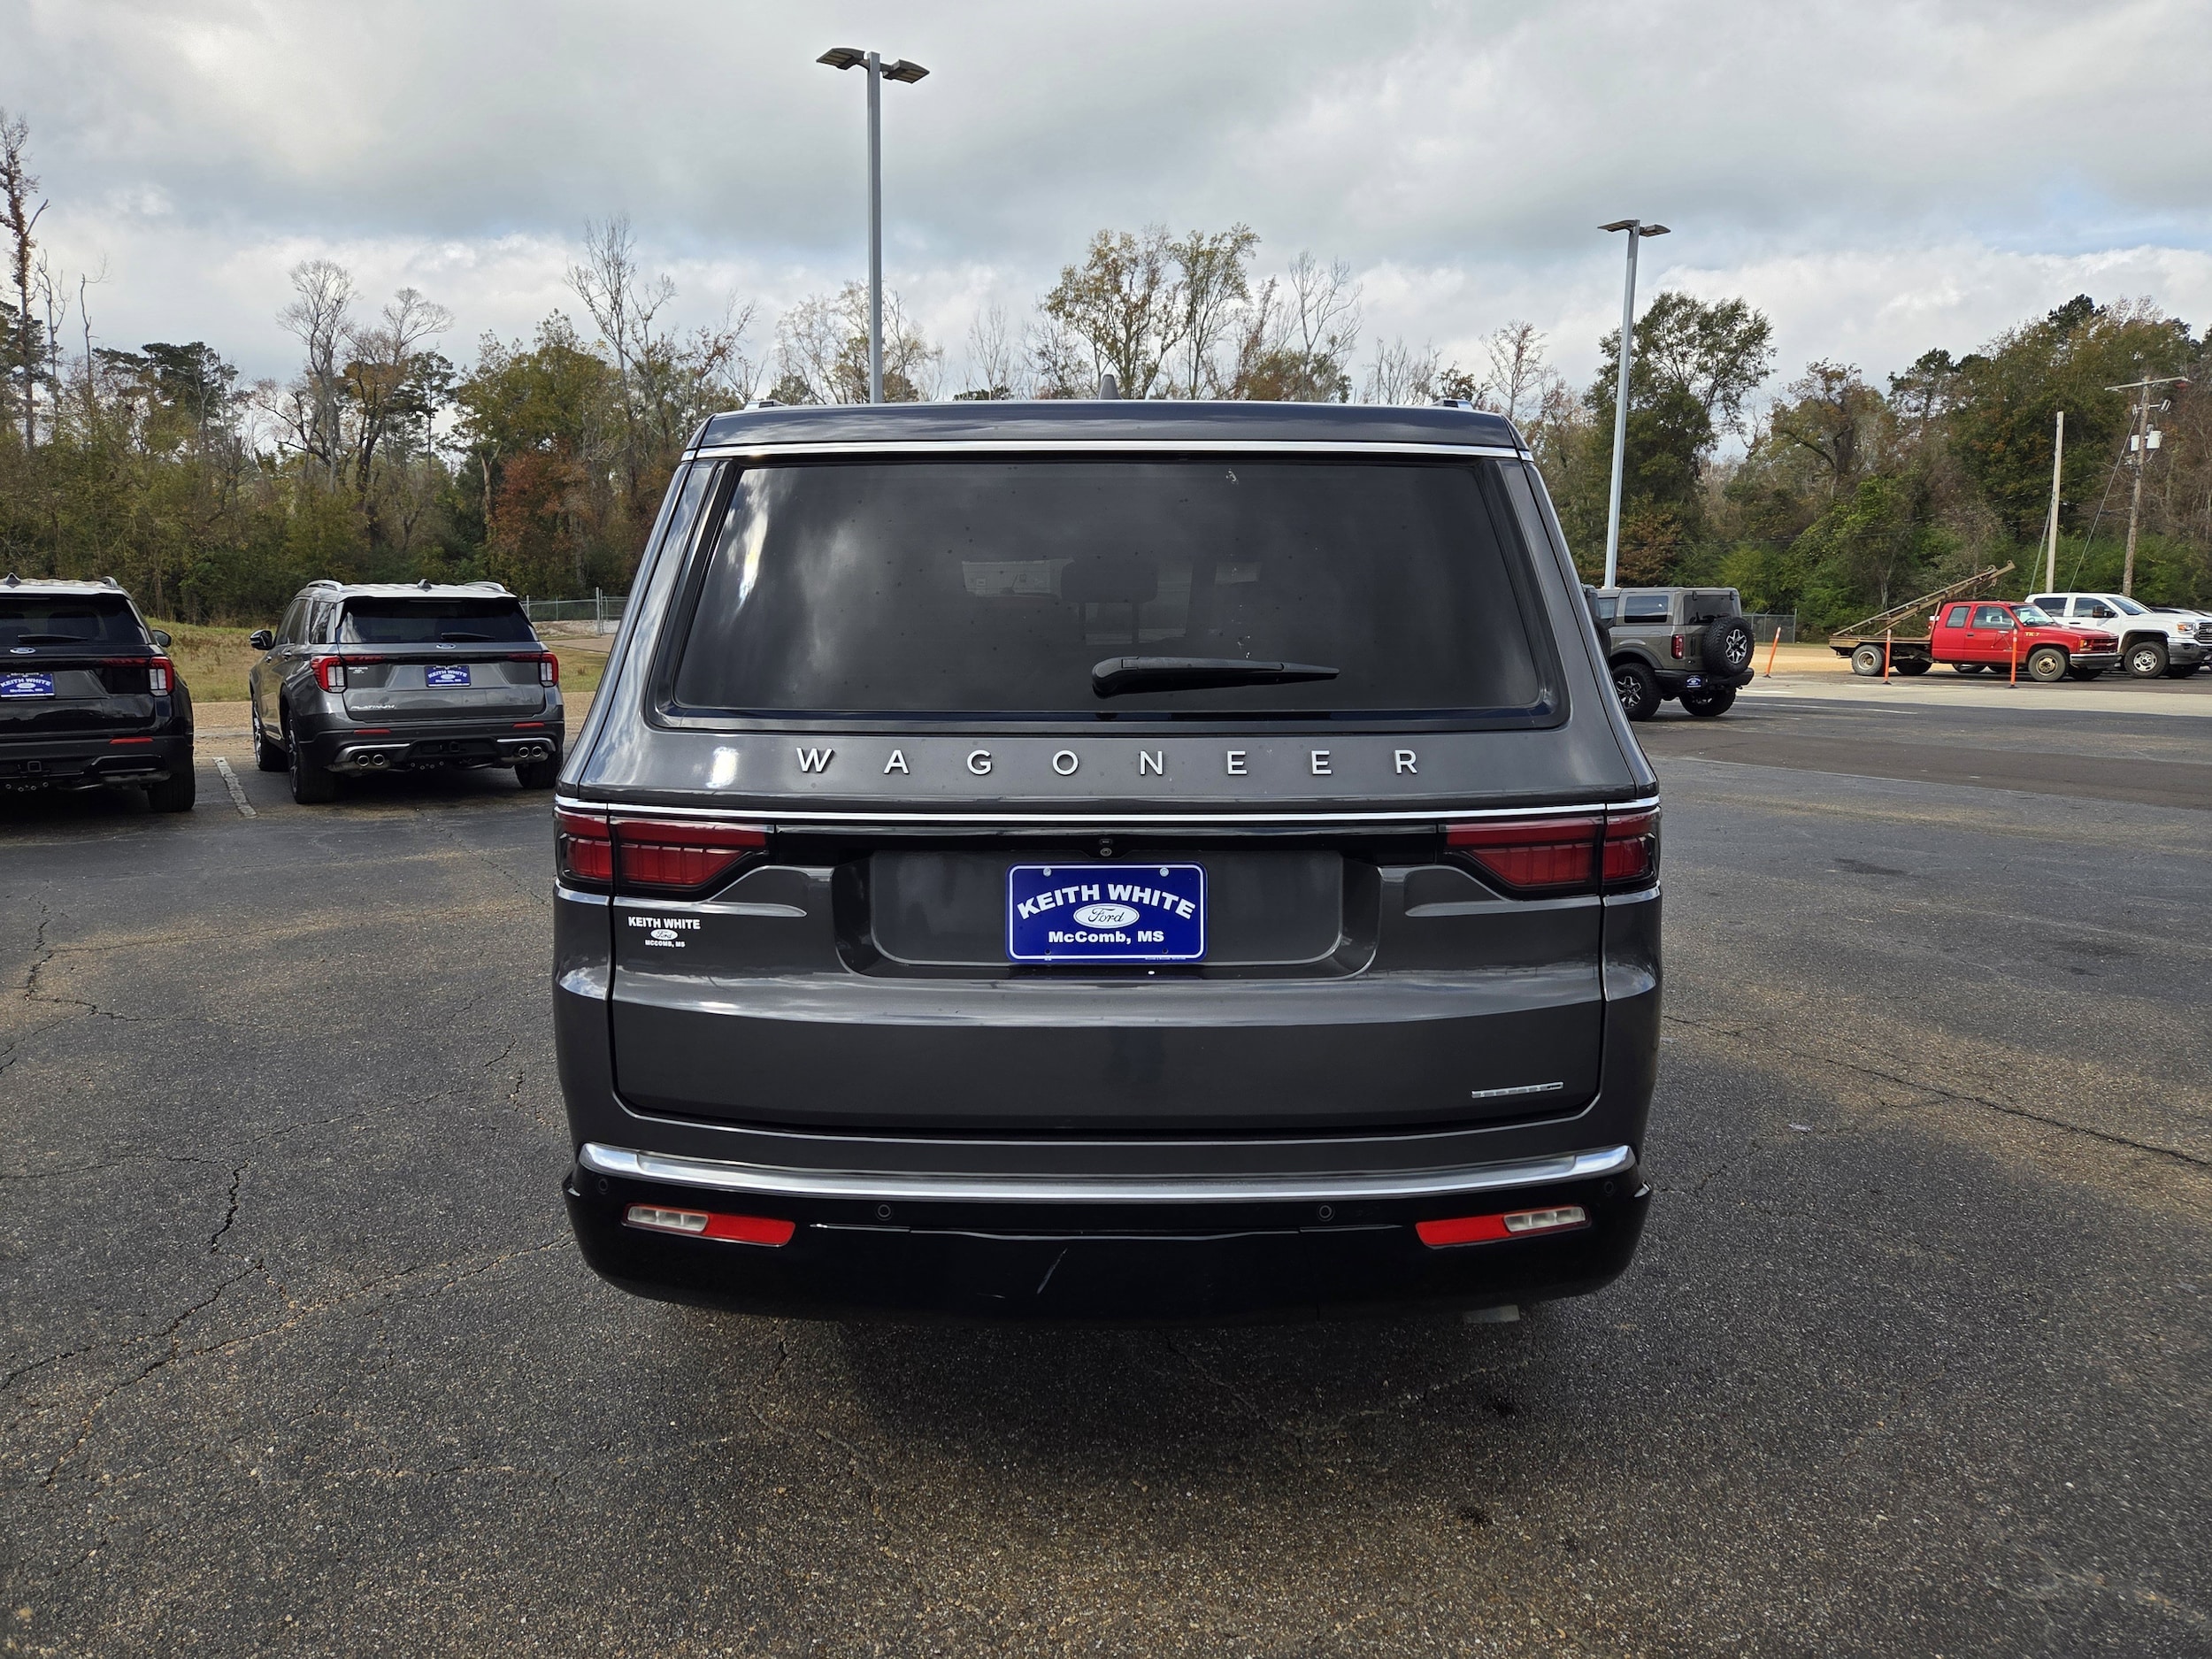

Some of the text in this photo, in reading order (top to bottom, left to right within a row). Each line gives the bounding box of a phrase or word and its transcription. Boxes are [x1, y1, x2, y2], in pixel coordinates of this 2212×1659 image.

[428, 670, 447, 679] KEITH
[0, 678, 25, 687] KEITH
[25, 678, 51, 687] WHITE
[795, 747, 1418, 776] WAGONEER
[1017, 883, 1196, 920] KEITH WHITE
[1087, 908, 1125, 923] Ford
[627, 916, 702, 930] KEITH WHITE
[656, 930, 672, 939] Ford
[1048, 930, 1164, 944] McComb, MS
